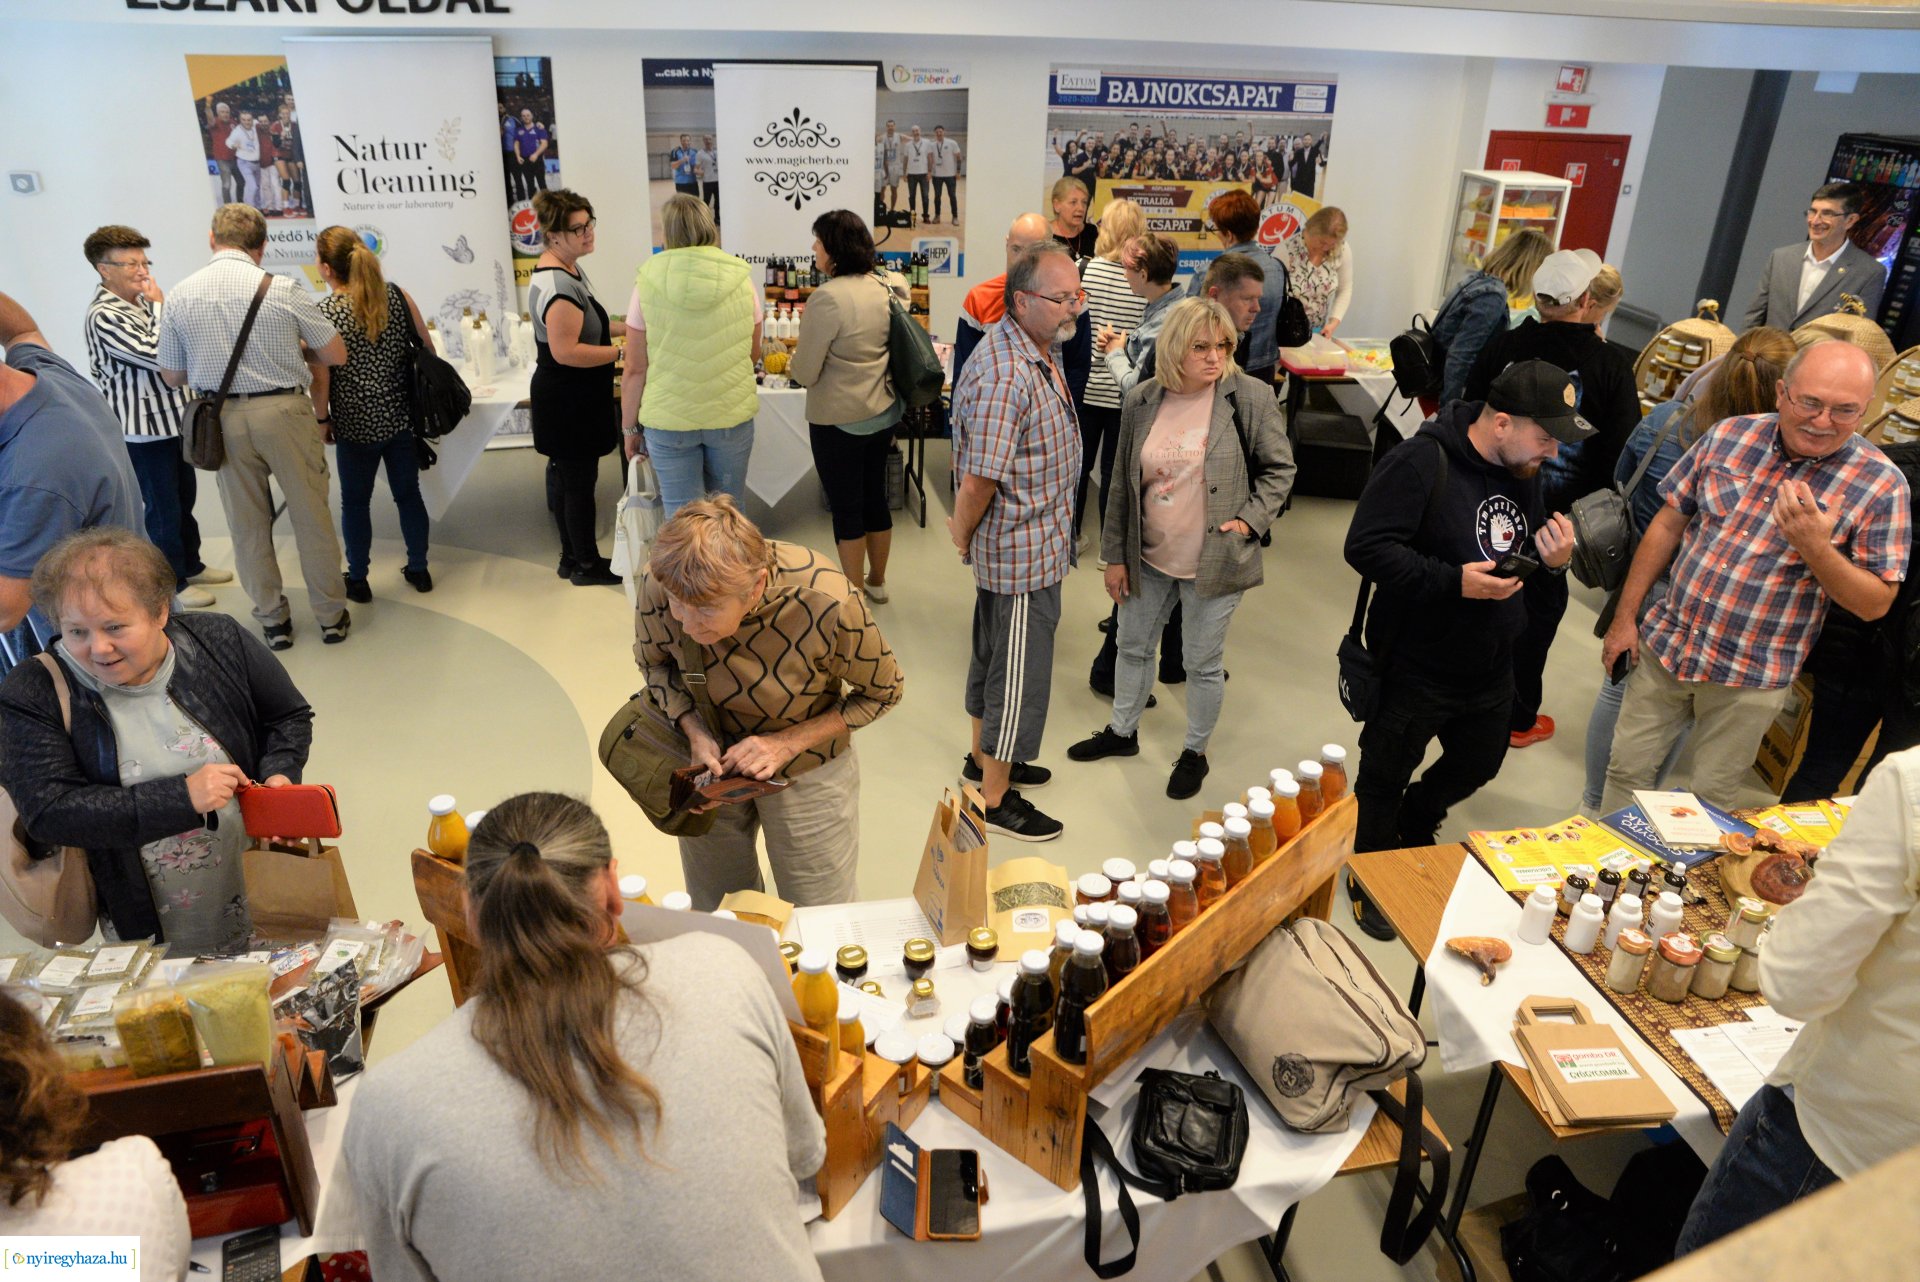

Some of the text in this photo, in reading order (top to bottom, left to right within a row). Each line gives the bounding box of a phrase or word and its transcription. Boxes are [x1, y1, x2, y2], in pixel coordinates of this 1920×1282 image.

[1107, 80, 1283, 108] BAJNOKCSAPAT
[331, 134, 427, 162] Natur
[745, 155, 849, 167] www.magicherb.eu
[336, 166, 477, 199] Cleaning
[343, 201, 374, 211] Nature
[377, 201, 385, 210] is
[404, 200, 454, 210] laboratory
